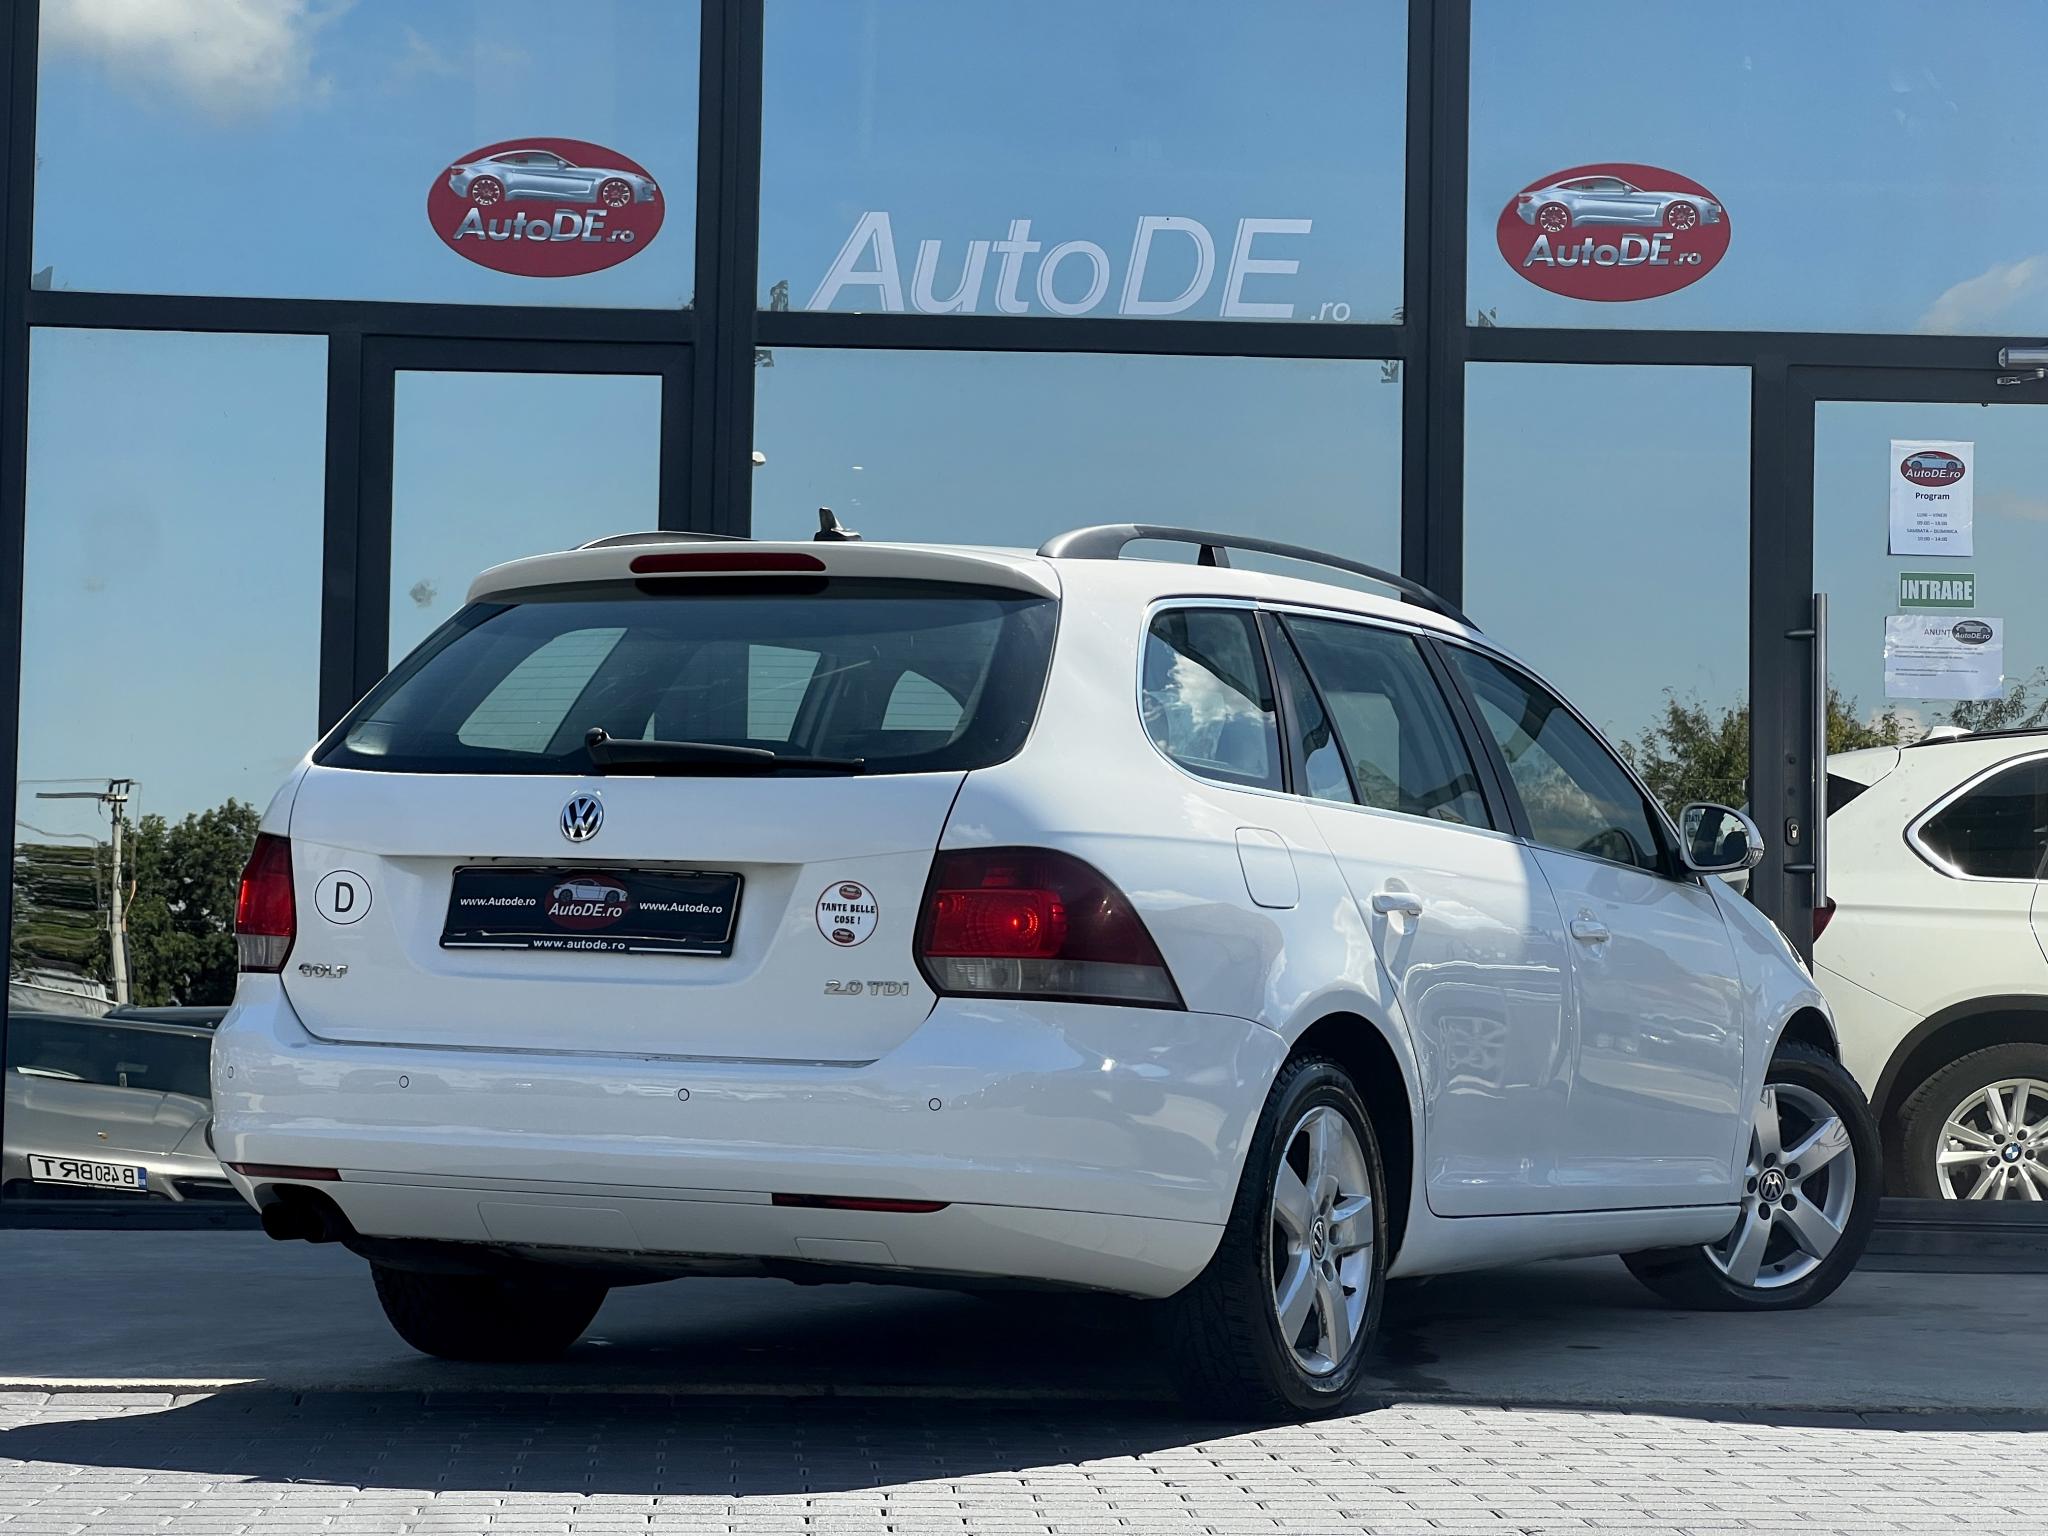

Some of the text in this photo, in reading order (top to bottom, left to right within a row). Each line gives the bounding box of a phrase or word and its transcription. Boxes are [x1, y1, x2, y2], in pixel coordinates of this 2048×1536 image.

[1905, 468, 1961, 479] AutoDE.ro
[1915, 492, 1950, 502] Program
[1901, 579, 1973, 600] INTRARE
[335, 882, 354, 912] D
[459, 896, 537, 907] www.Autode.ro
[548, 902, 623, 918] AutoDE.ro
[639, 900, 723, 914] www.Autode.ro
[821, 902, 876, 914] TANTE BELLE
[834, 915, 856, 925] COSE
[532, 938, 626, 951] www.autode.ro
[299, 962, 348, 979] GOLF
[867, 981, 910, 997] TDI
